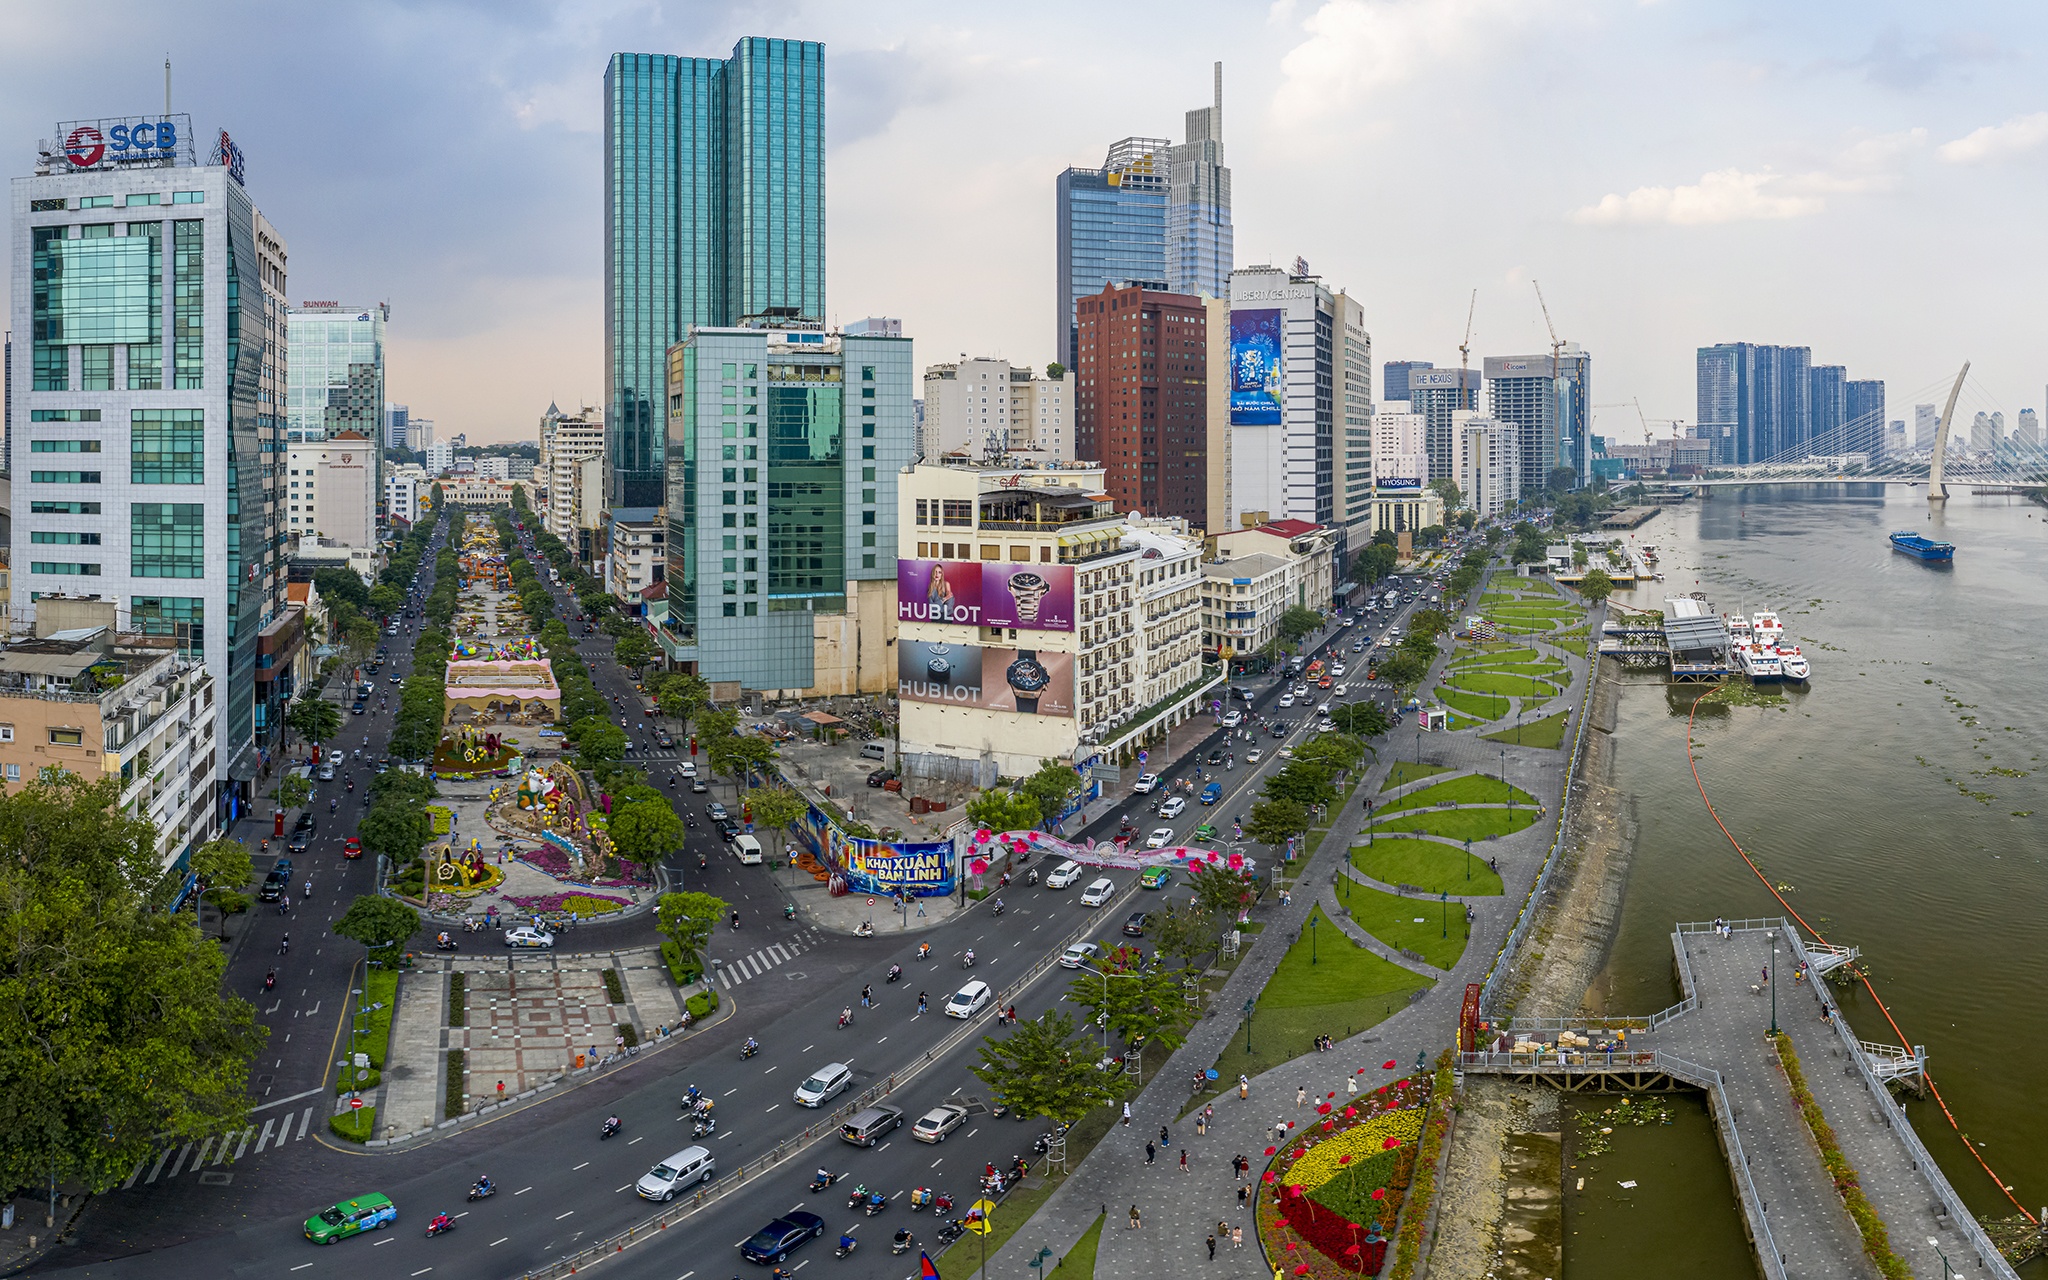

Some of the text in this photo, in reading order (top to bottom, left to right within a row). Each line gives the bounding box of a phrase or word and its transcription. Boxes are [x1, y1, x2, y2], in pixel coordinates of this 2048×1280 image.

[110, 122, 176, 150] SCB
[1235, 288, 1311, 301] LIBERTY CENTRAL
[303, 300, 338, 308] SUNWAH
[1416, 374, 1452, 384] THE NEXUS
[899, 601, 981, 623] HUBLOT
[899, 679, 981, 703] HUBLOT
[866, 853, 939, 870] KHAI XUÂN
